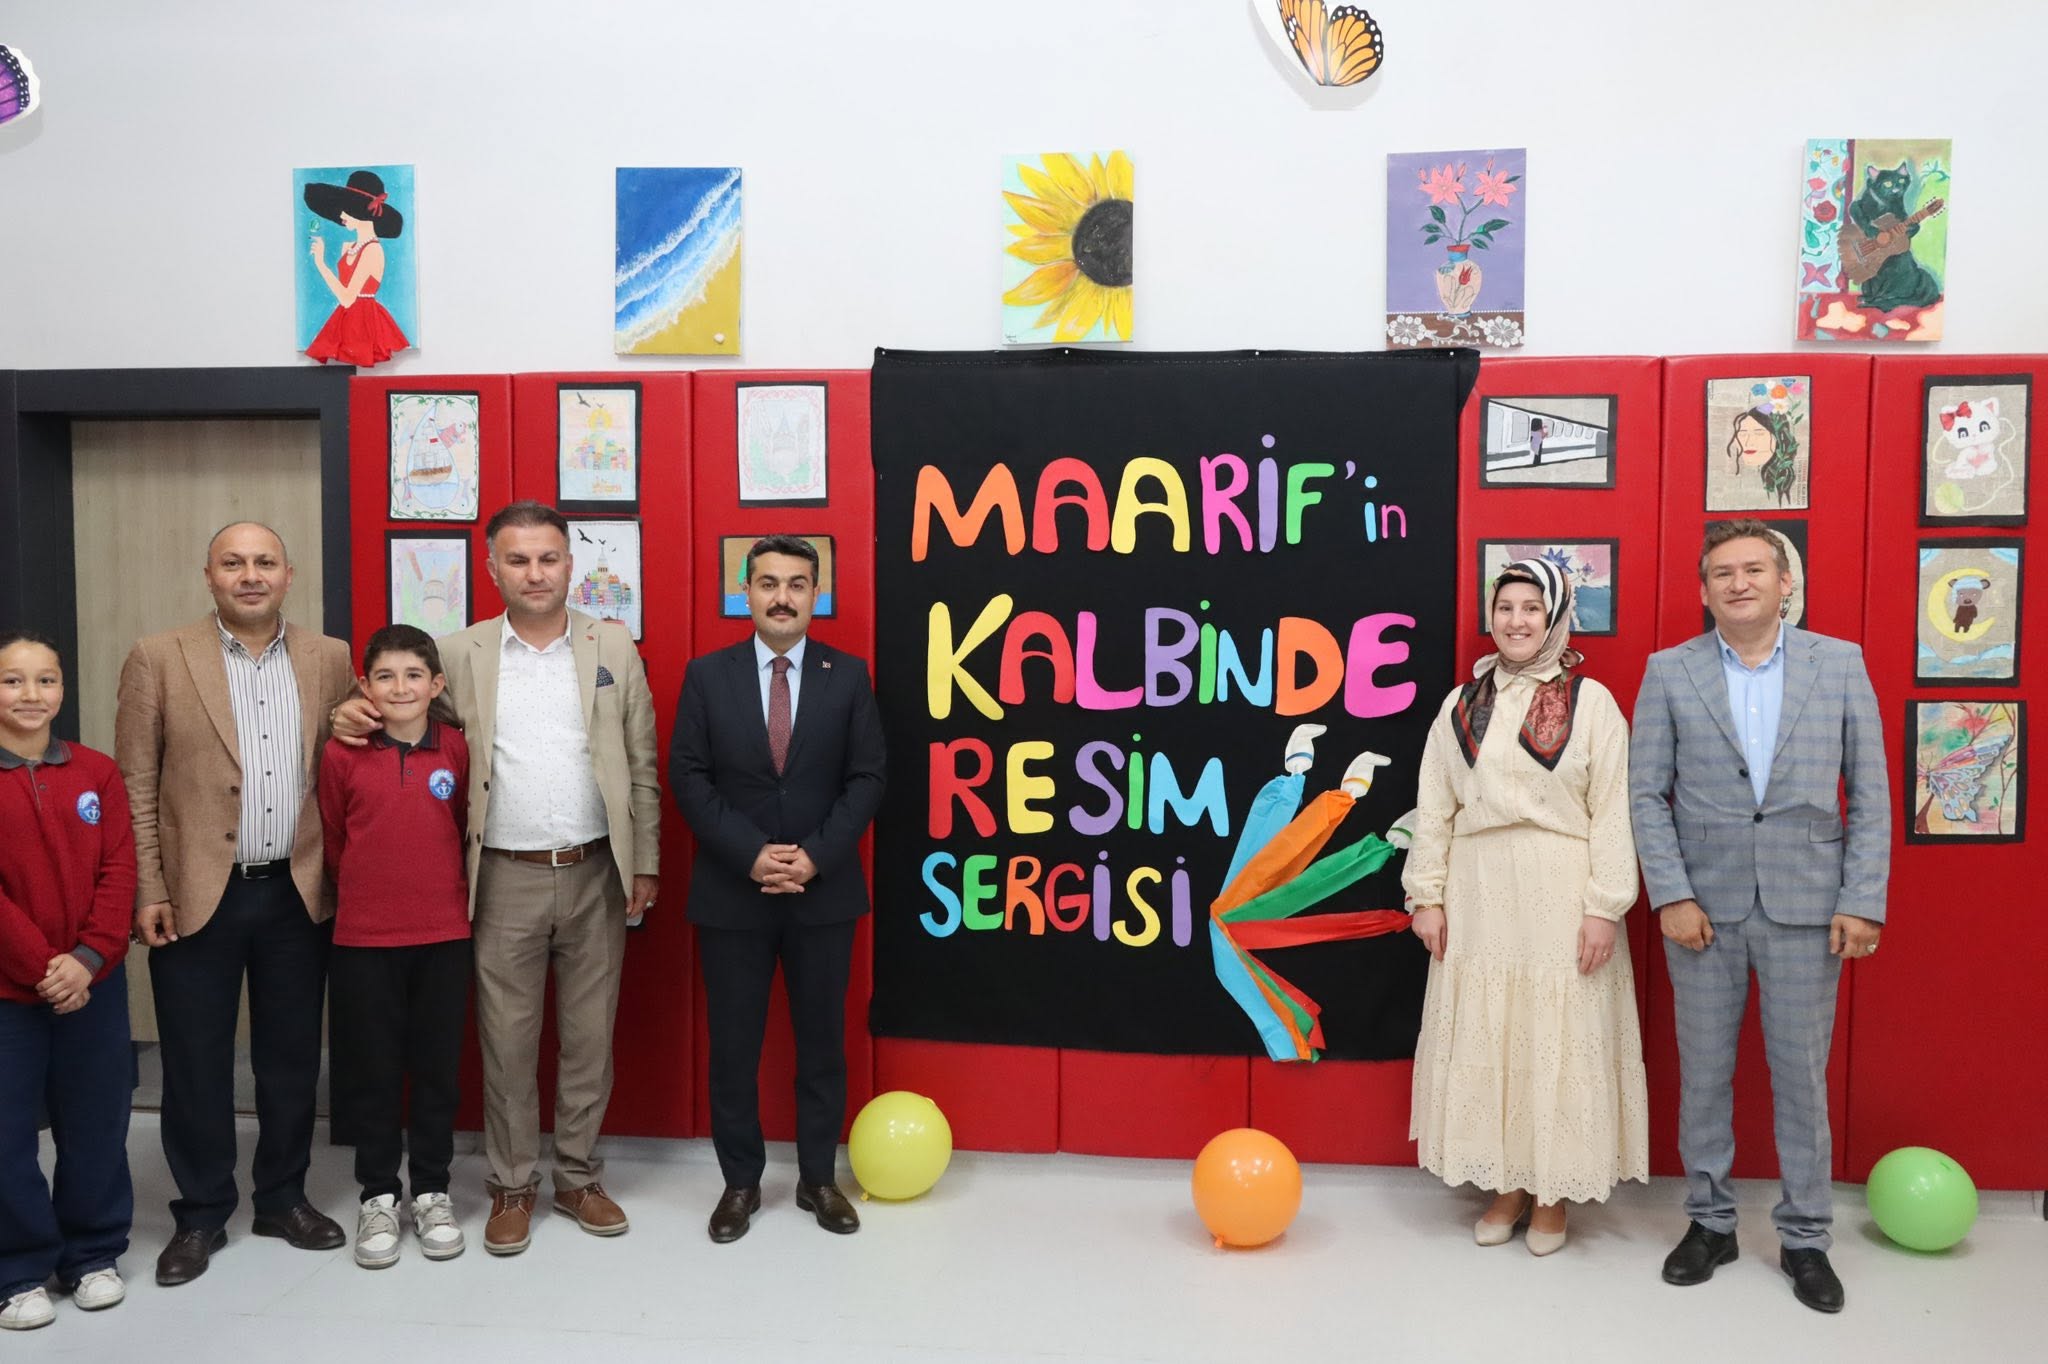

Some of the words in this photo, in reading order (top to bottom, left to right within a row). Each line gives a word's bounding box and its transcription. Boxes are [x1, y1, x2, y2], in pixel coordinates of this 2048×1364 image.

[927, 594, 1416, 720] KALBİNDE
[929, 733, 1230, 838] RESİM
[920, 851, 1192, 947] SERGİSİ
